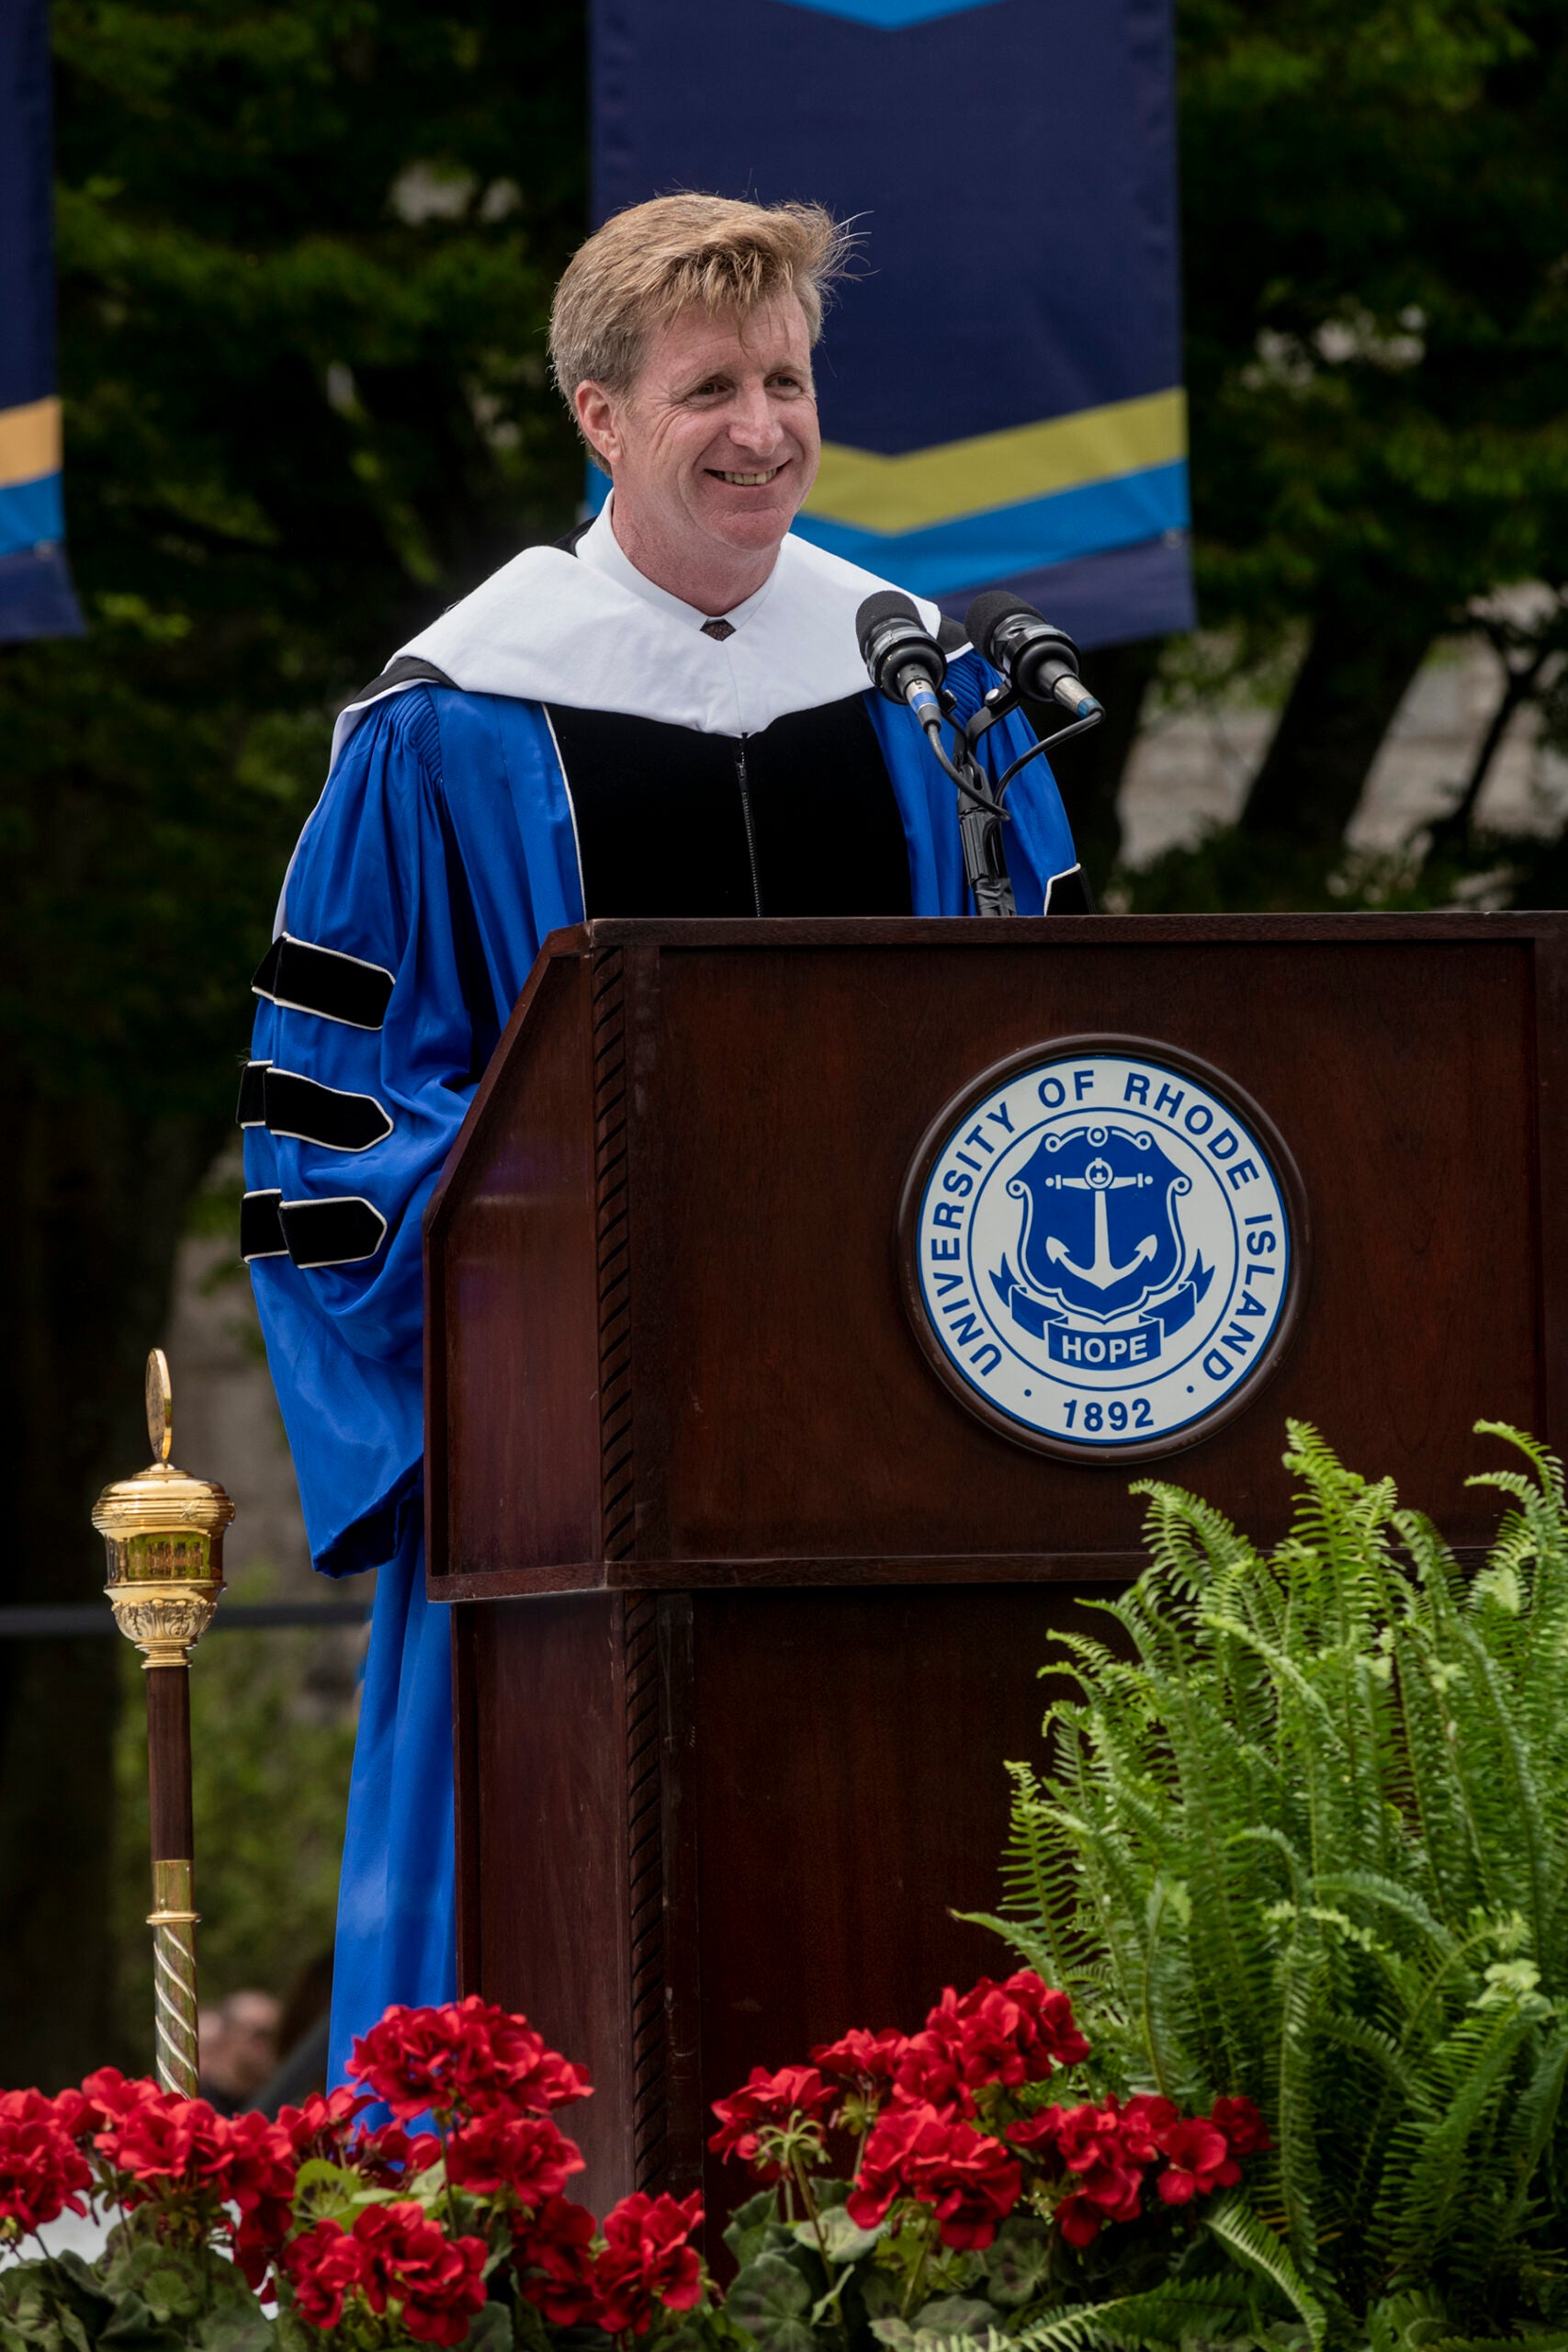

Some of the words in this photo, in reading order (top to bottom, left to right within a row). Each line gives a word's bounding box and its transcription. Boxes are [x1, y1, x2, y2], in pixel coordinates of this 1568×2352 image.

[931, 1102, 1018, 1377] UNIVERSITY
[1038, 1070, 1095, 1108] OF
[1123, 1072, 1260, 1192] RHODE
[1201, 1214, 1277, 1382] ISLAND
[1062, 1334, 1148, 1363] HOPE
[1063, 1398, 1155, 1431] 1892
